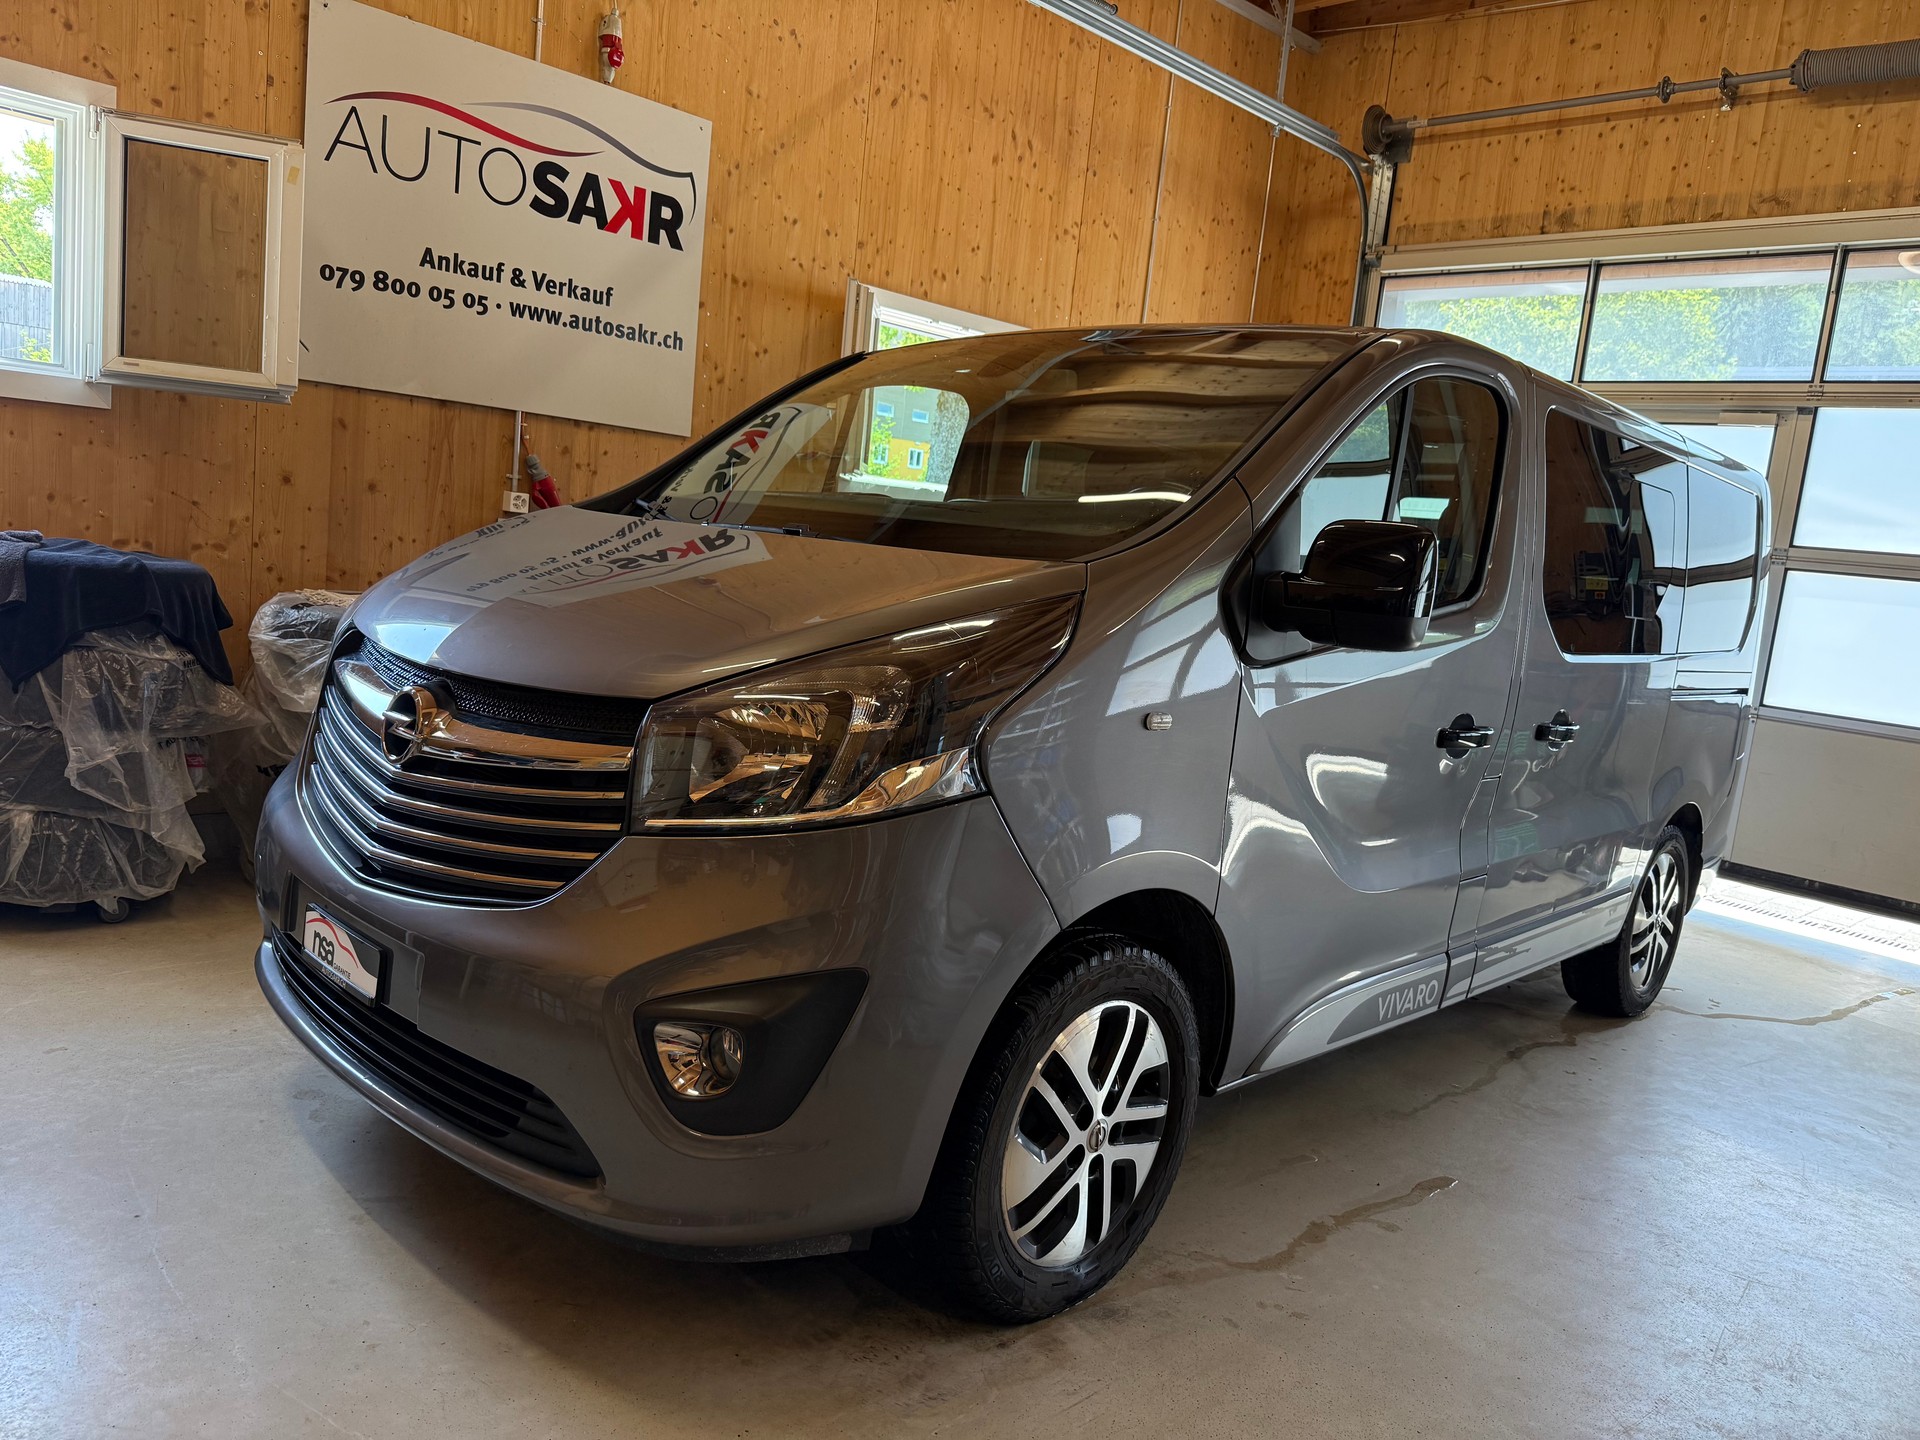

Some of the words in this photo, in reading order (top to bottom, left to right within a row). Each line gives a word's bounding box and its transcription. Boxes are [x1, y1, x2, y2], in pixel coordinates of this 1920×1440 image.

[324, 105, 685, 252] AUTOSAKR
[419, 246, 505, 285] Ankauf
[509, 266, 527, 289] &
[531, 270, 614, 307] Verkauf
[319, 263, 365, 292] 079
[372, 270, 421, 298] 800
[428, 285, 456, 310] 05
[462, 292, 489, 316] 05
[509, 301, 684, 352] www.autosakr.ch
[313, 930, 335, 968] nsa
[1379, 979, 1438, 1022] VIVARO
